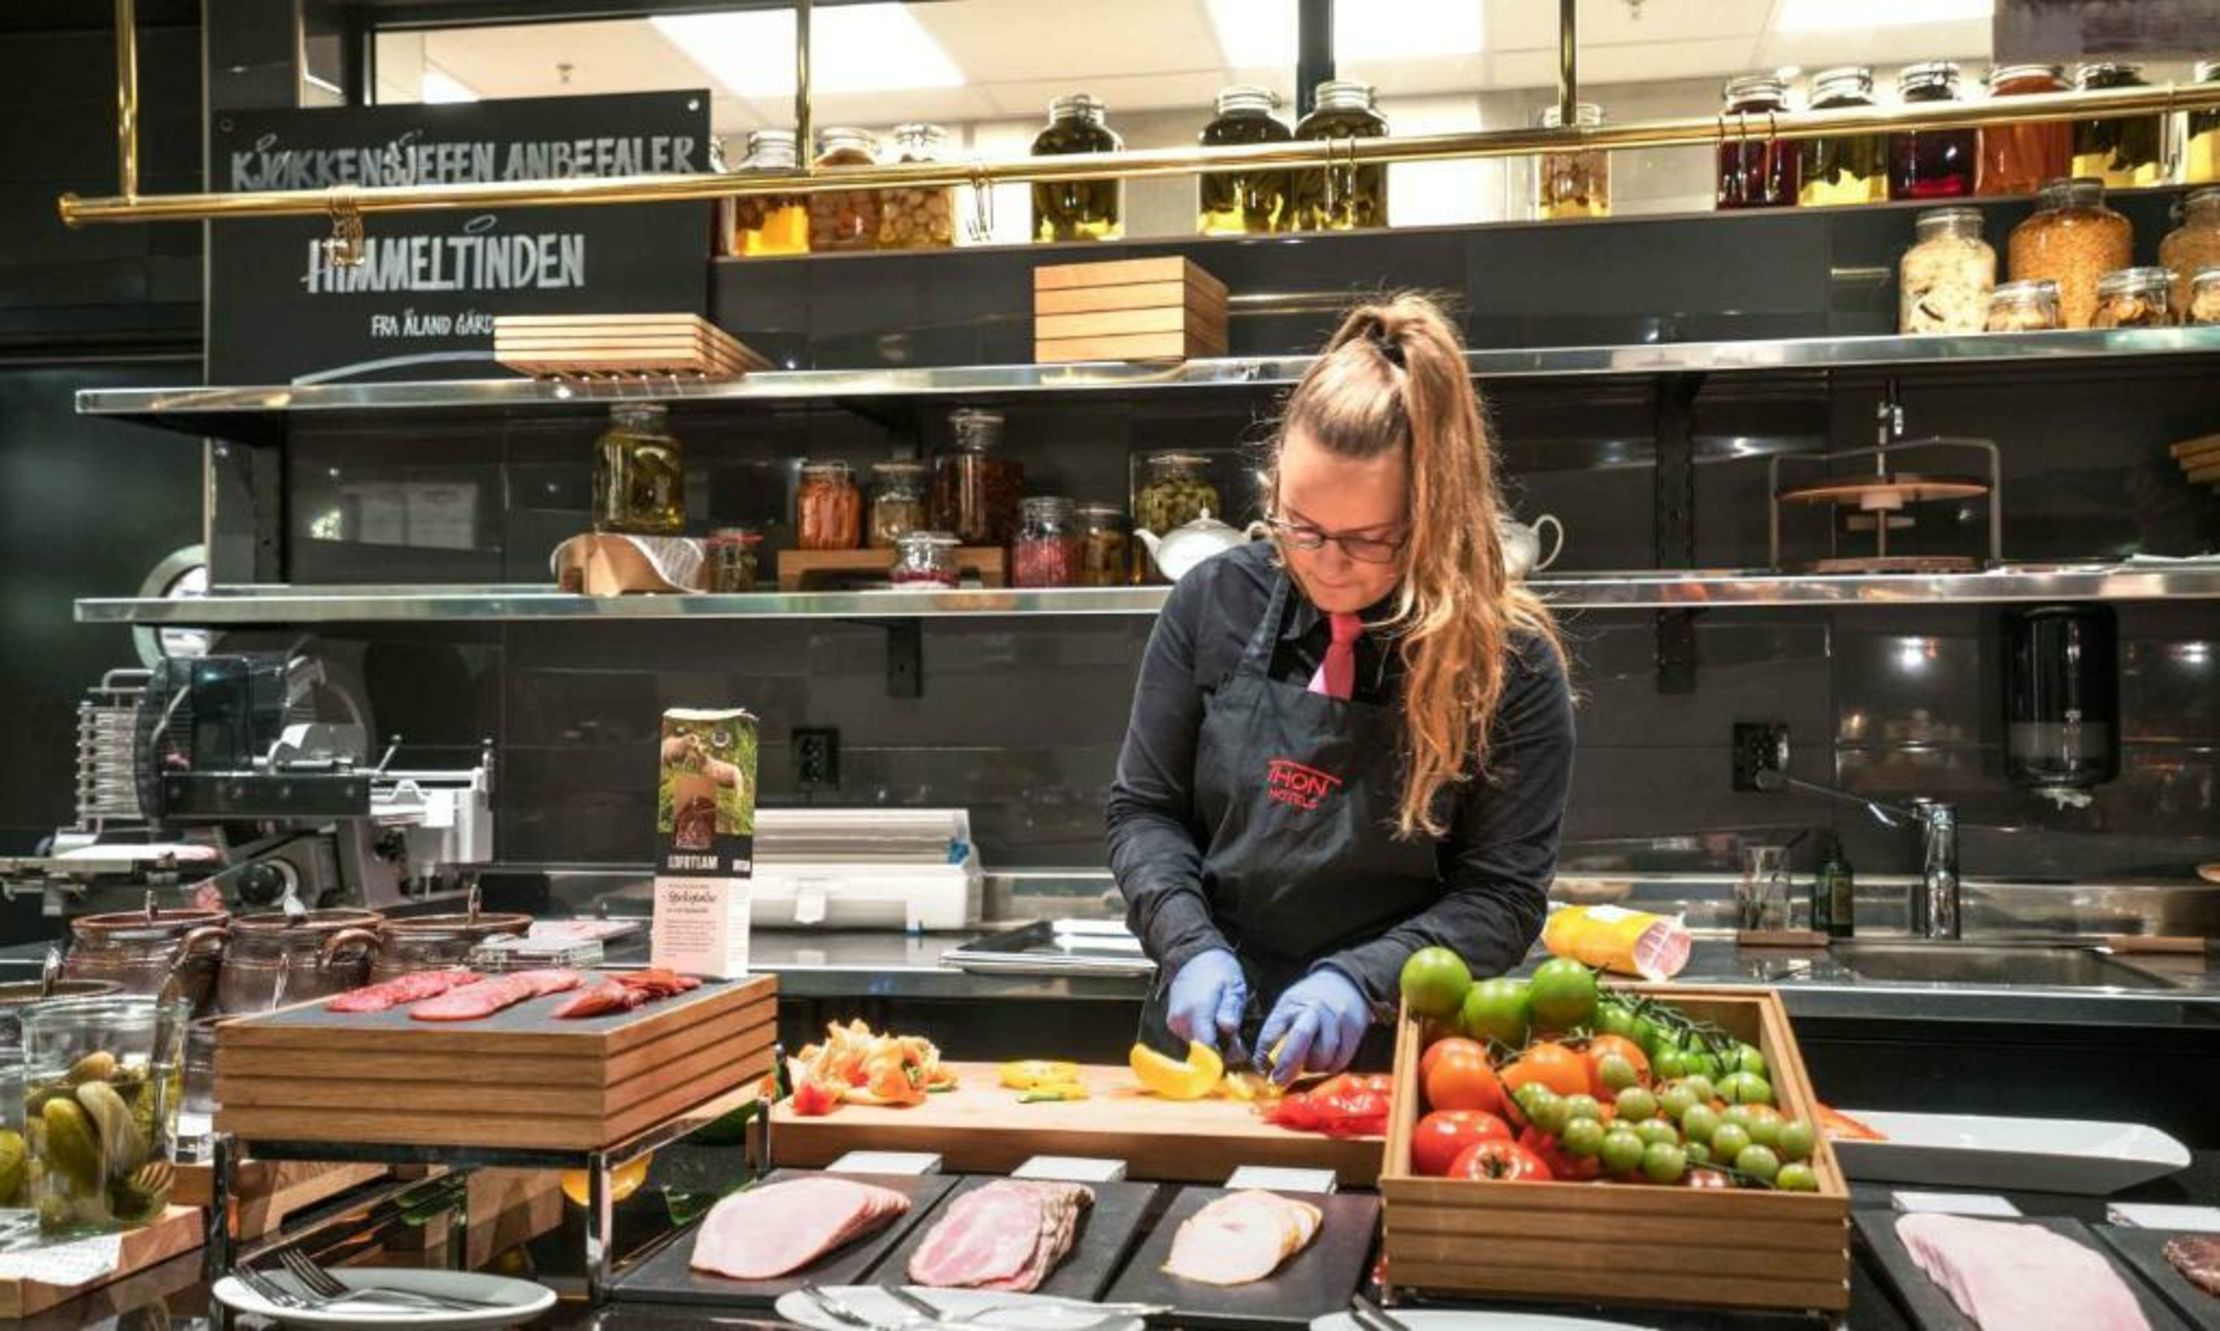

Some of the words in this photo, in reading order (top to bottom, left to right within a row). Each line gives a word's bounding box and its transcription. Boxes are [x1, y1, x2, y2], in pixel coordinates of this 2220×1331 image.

[503, 136, 695, 180] ANBEFALER
[370, 314, 398, 337] FRA
[1267, 759, 1343, 797] THON
